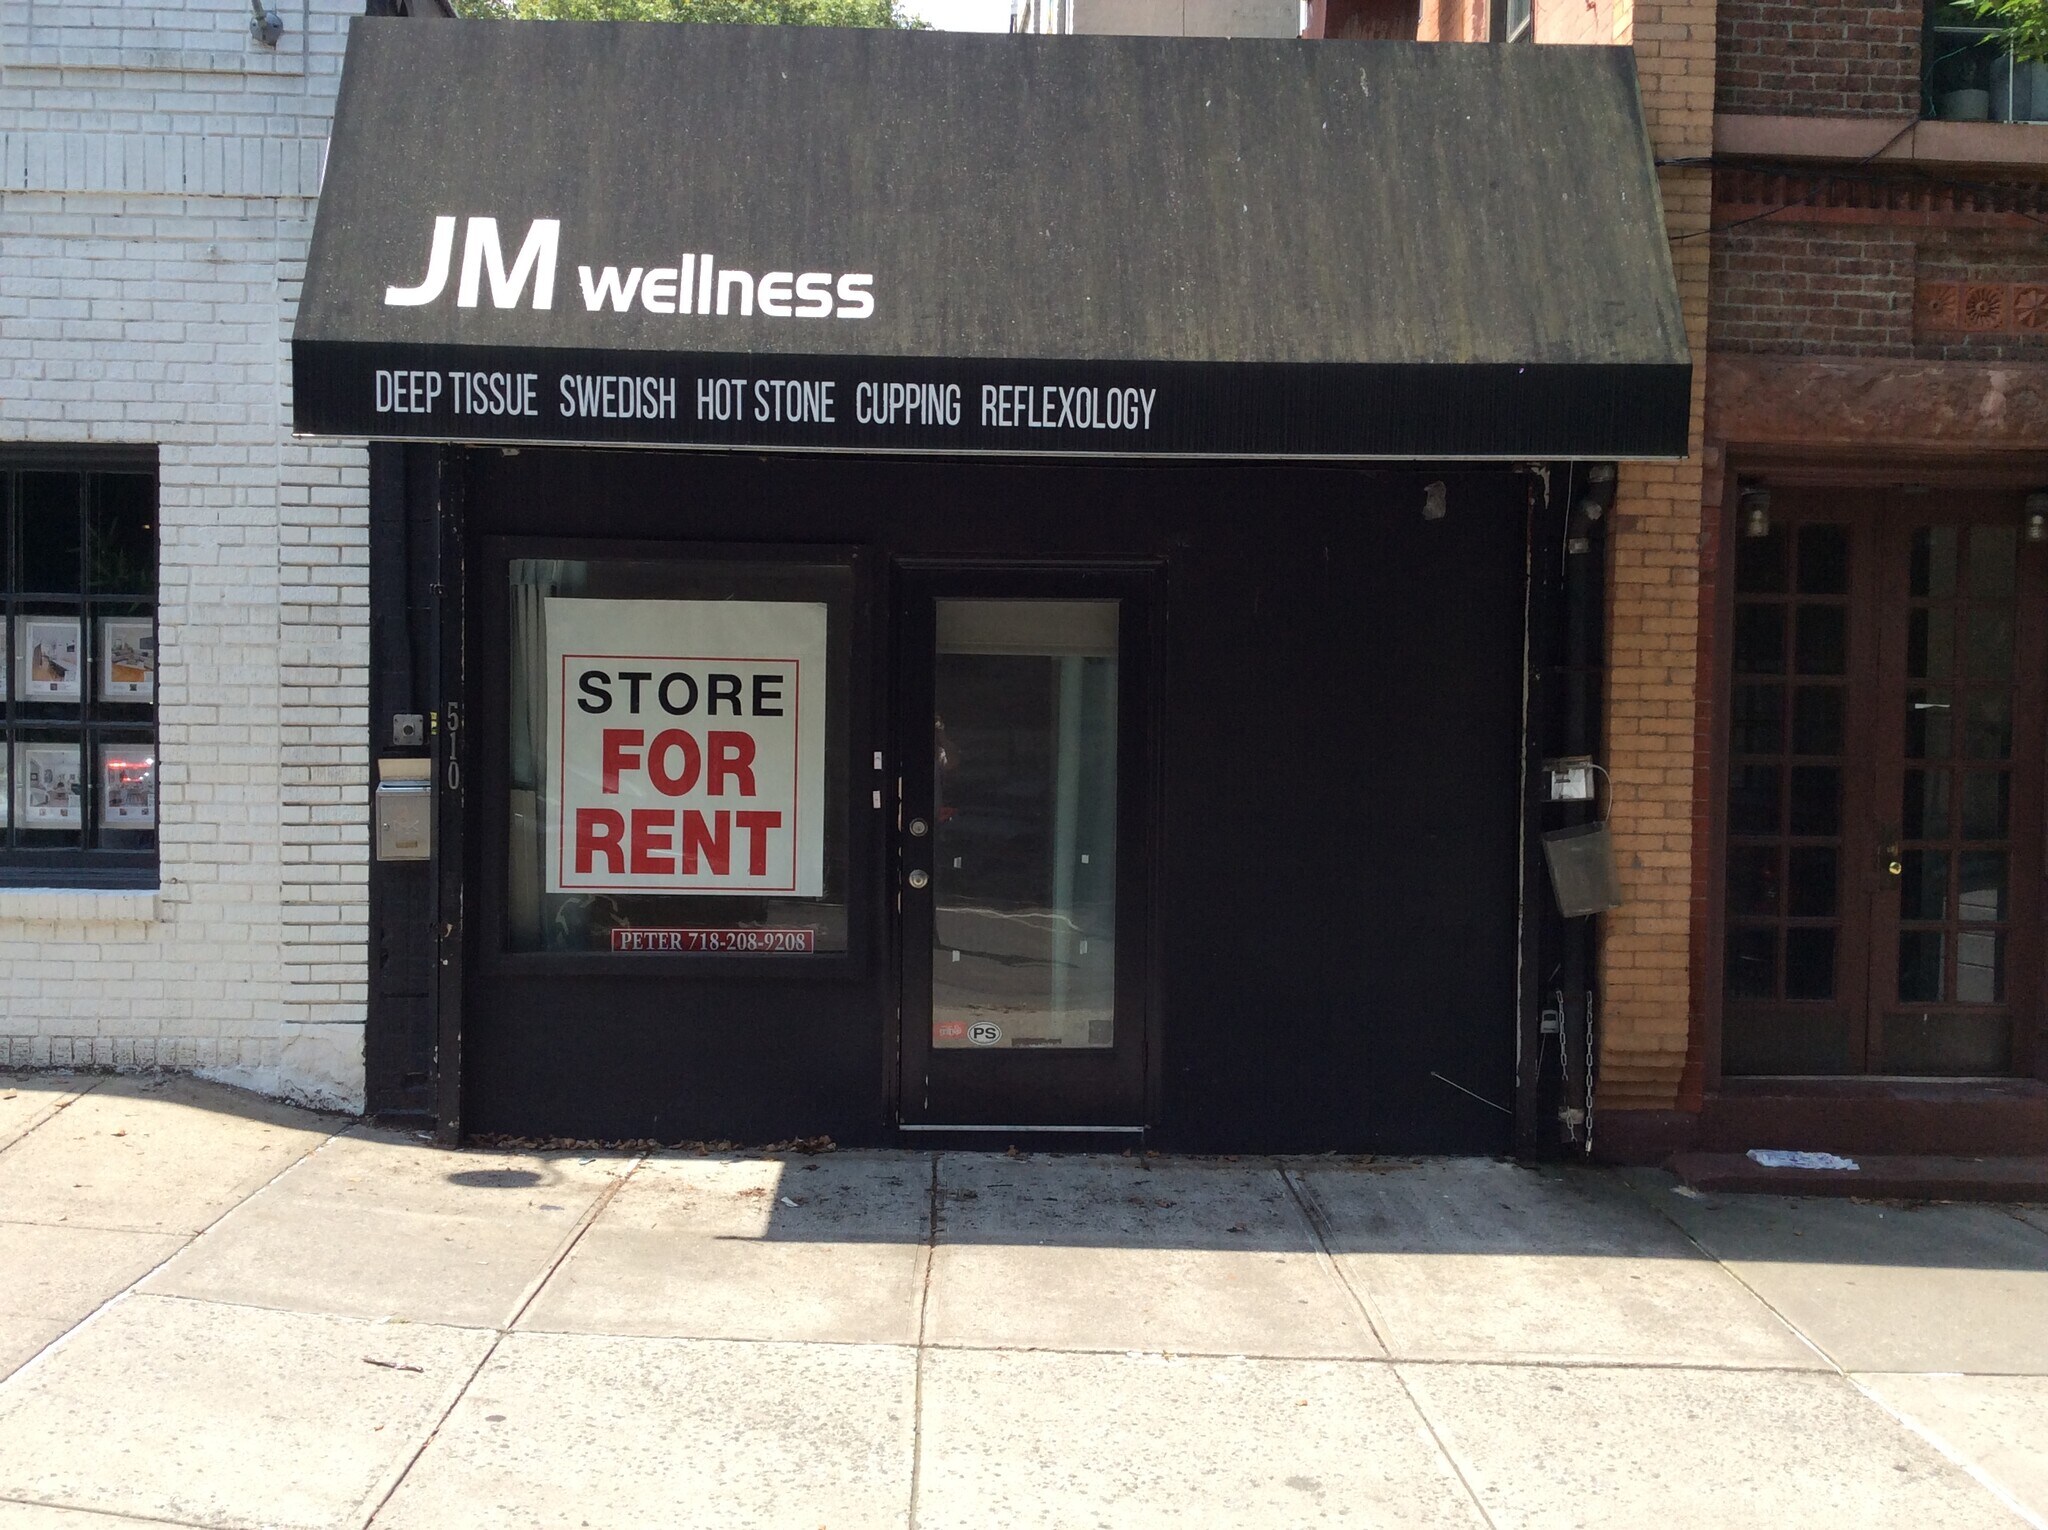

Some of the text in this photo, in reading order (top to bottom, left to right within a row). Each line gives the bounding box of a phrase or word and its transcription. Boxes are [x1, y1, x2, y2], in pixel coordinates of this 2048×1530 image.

[384, 215, 875, 319] JM wellness
[375, 370, 1157, 430] DEEP TISSUE SWEDISH HOT STONE CUPPING REFLEXOLOGY
[577, 670, 784, 717] STORE
[447, 701, 460, 790] 510
[602, 728, 756, 797] FOR
[575, 808, 782, 876] RENT
[620, 932, 806, 951] PETER 718-208-9208
[973, 1027, 997, 1039] PS
